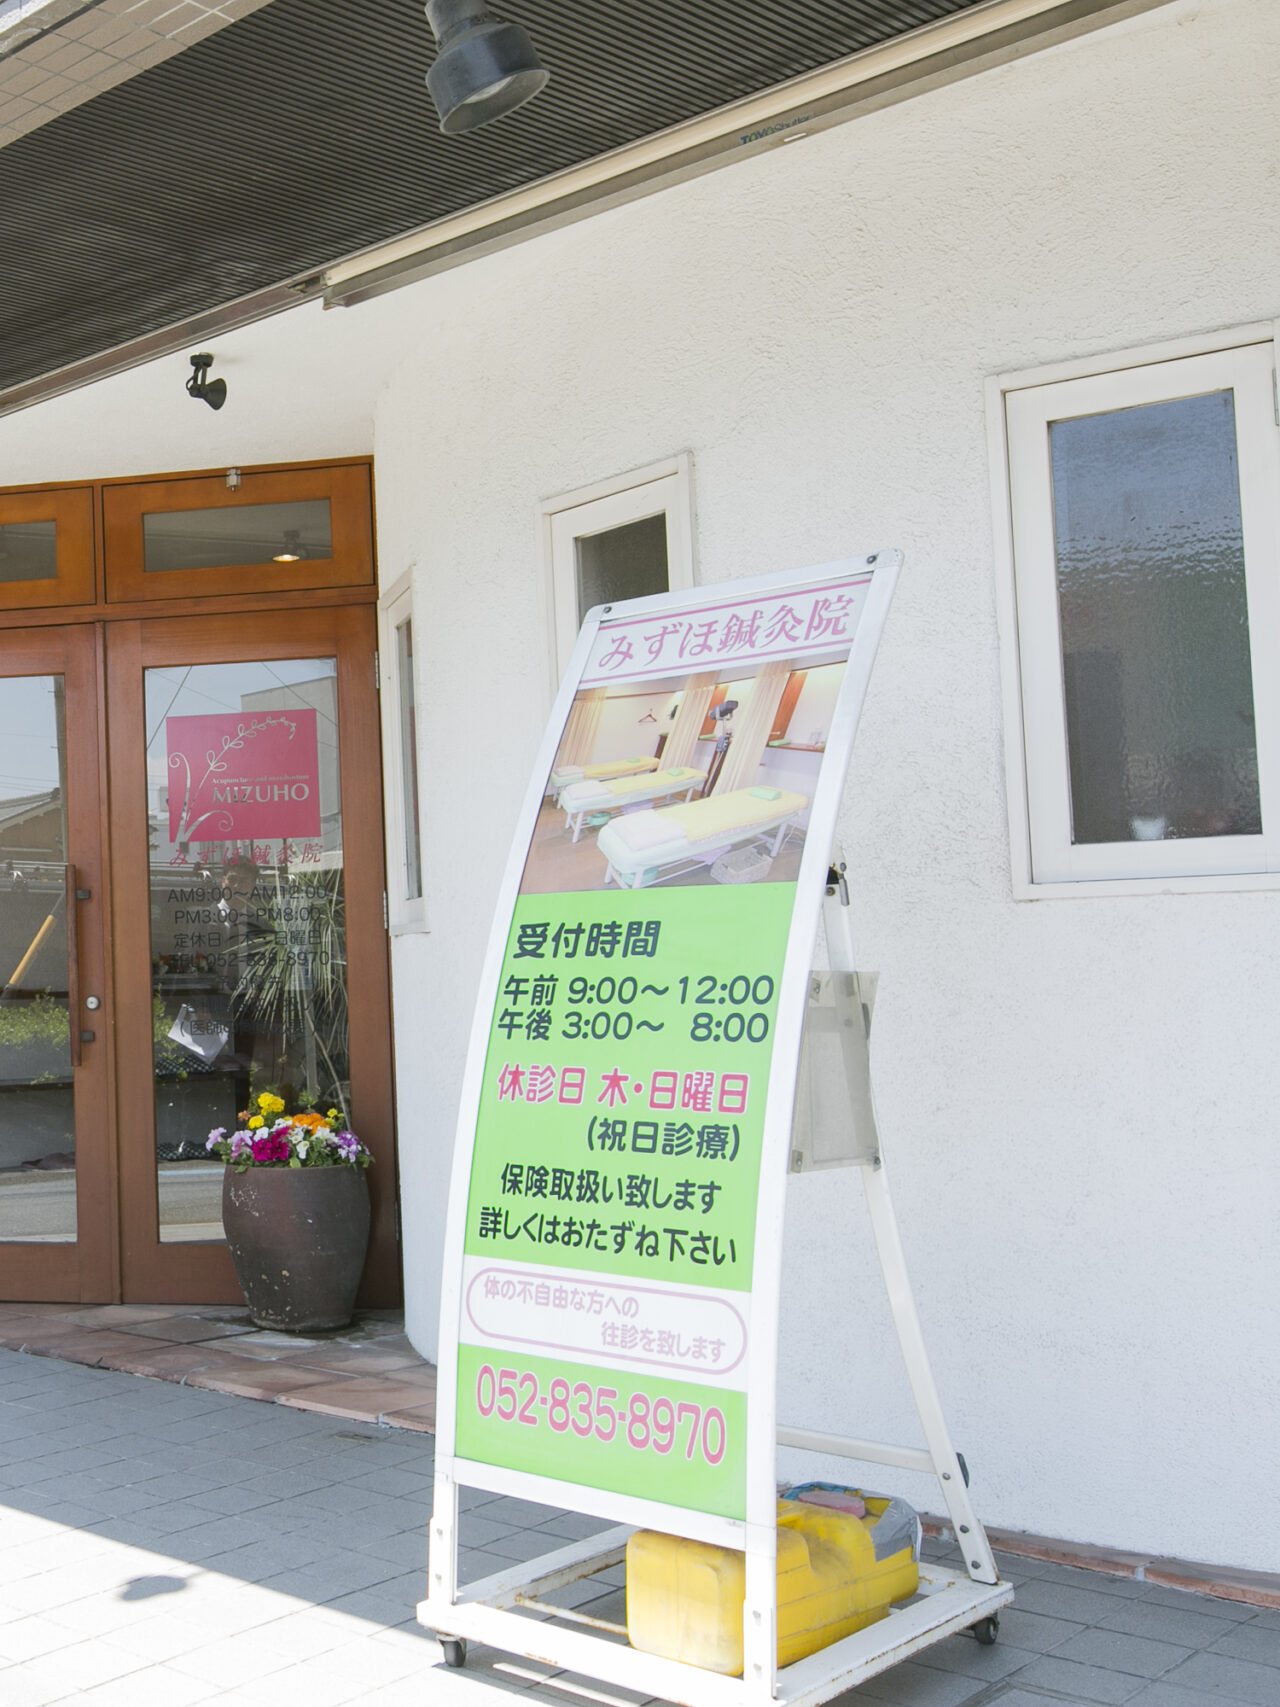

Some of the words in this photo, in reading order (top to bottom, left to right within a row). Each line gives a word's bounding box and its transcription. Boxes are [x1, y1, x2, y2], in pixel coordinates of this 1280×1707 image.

[598, 594, 854, 672] みずほ鍼灸院
[212, 783, 309, 804] MIZUHO
[170, 843, 323, 868] みずほ鍼灸院
[513, 920, 661, 959] 受付時間
[503, 974, 558, 1006] 午前
[498, 1008, 553, 1041] 午後
[498, 1064, 586, 1104] 休診日
[597, 1068, 749, 1114] 木・日曜日
[587, 1116, 740, 1161] （祝日診療）
[501, 1163, 722, 1214] 保険取扱い致します
[479, 1207, 736, 1265] 詳しくはおたずね下さい
[484, 1275, 639, 1318] 体の不自由な方への
[601, 1322, 726, 1363] 往診を致します
[477, 1365, 726, 1465] 052-835-8970
